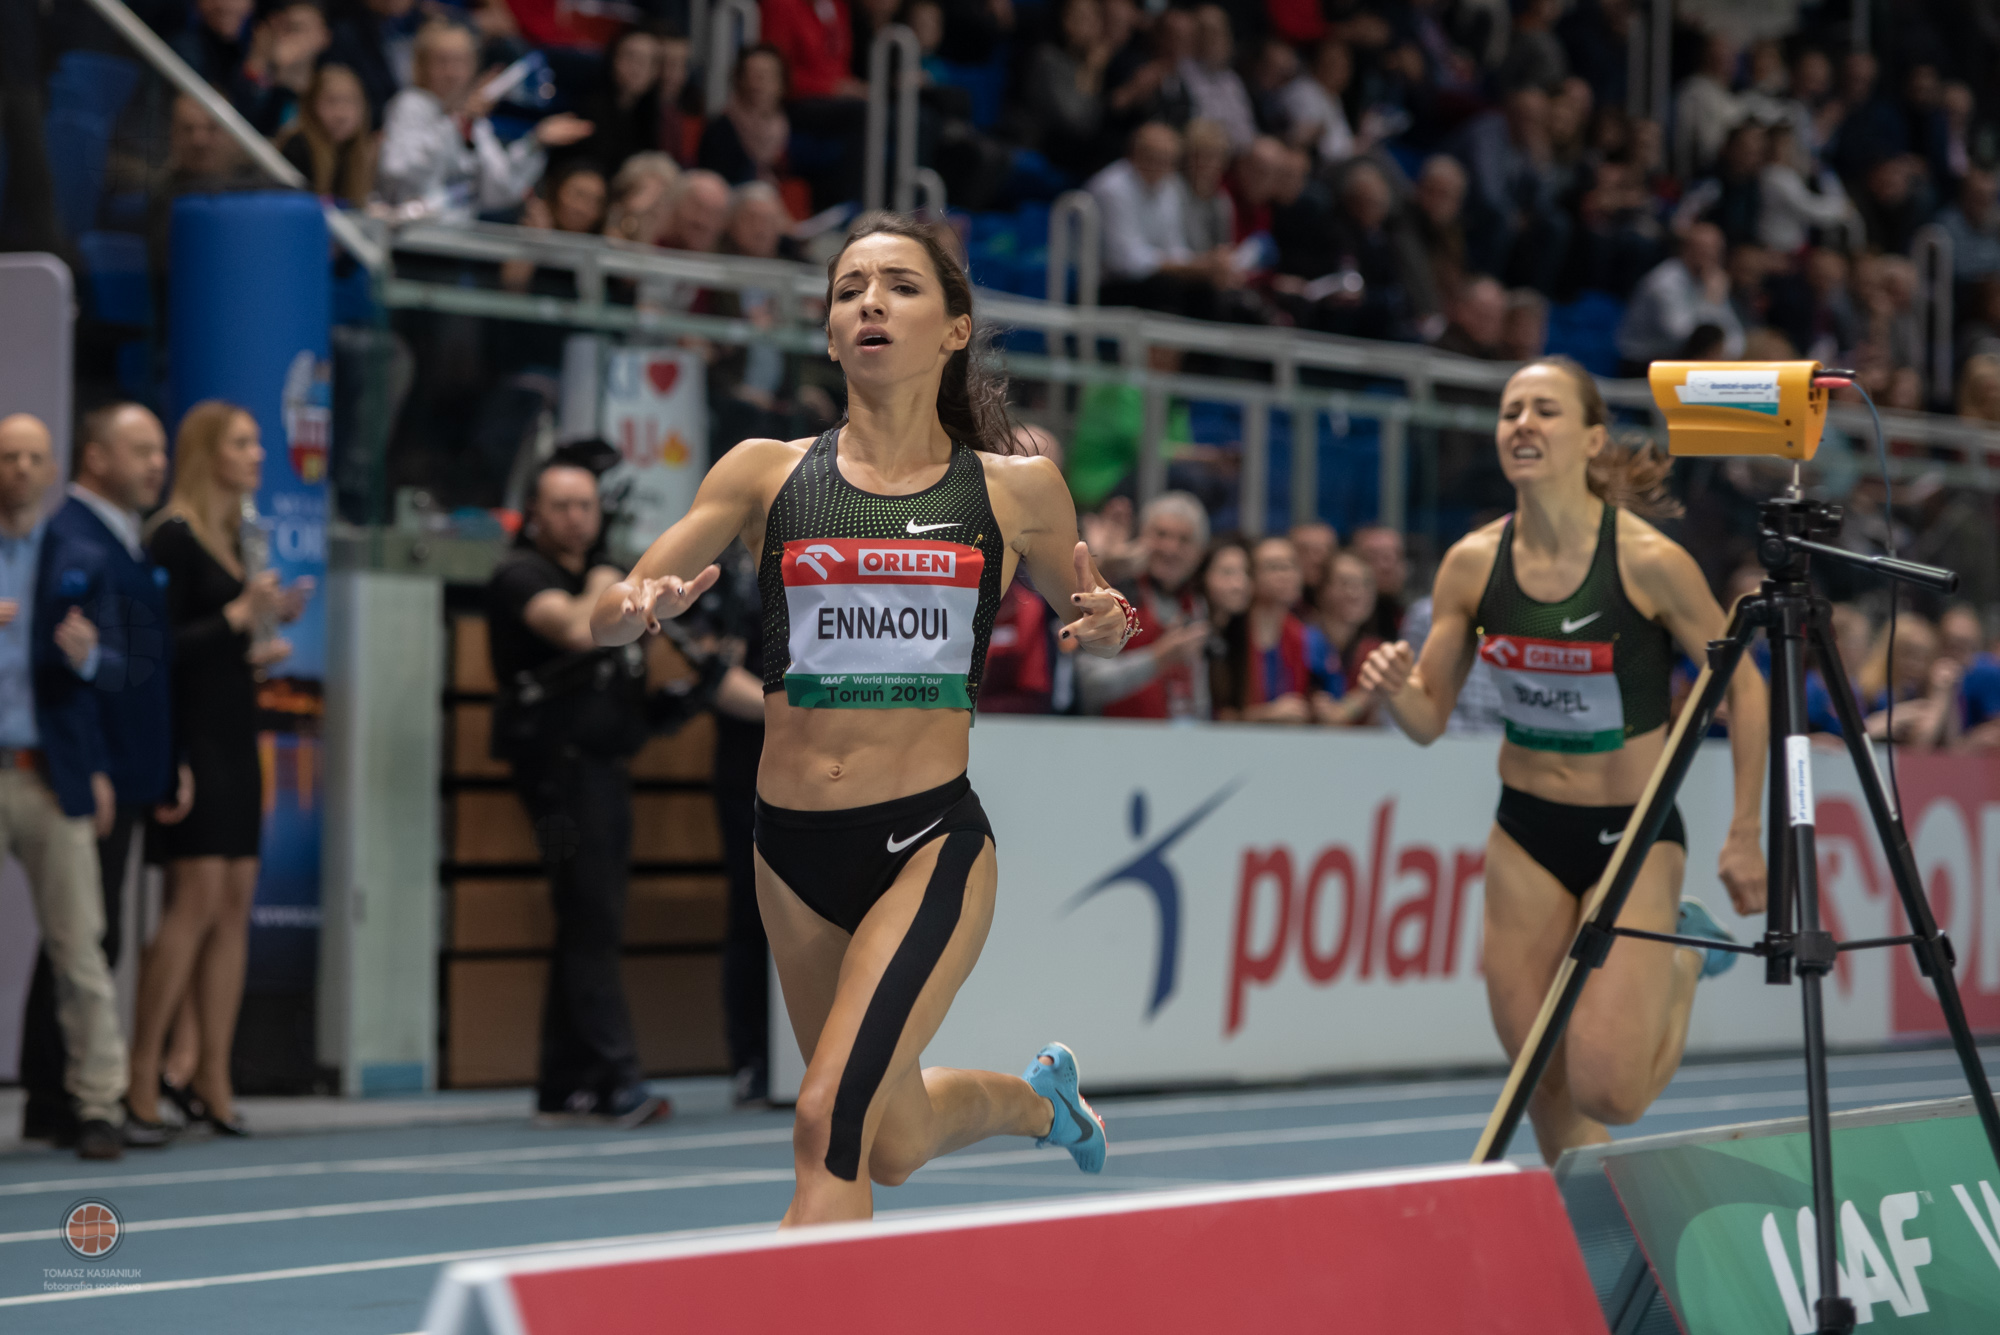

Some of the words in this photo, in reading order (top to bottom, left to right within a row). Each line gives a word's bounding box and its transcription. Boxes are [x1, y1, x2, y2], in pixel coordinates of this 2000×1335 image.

[863, 553, 950, 573] ORLEN
[818, 607, 948, 640] ENNAOUI
[1530, 651, 1586, 666] ORLEN
[820, 675, 848, 685] IAAF
[853, 675, 881, 685] World
[884, 675, 917, 685] Indoor
[920, 676, 943, 685] Tour
[826, 686, 884, 703] Toruń
[891, 686, 940, 702] 2019
[1761, 1191, 1932, 1335] IAAF
